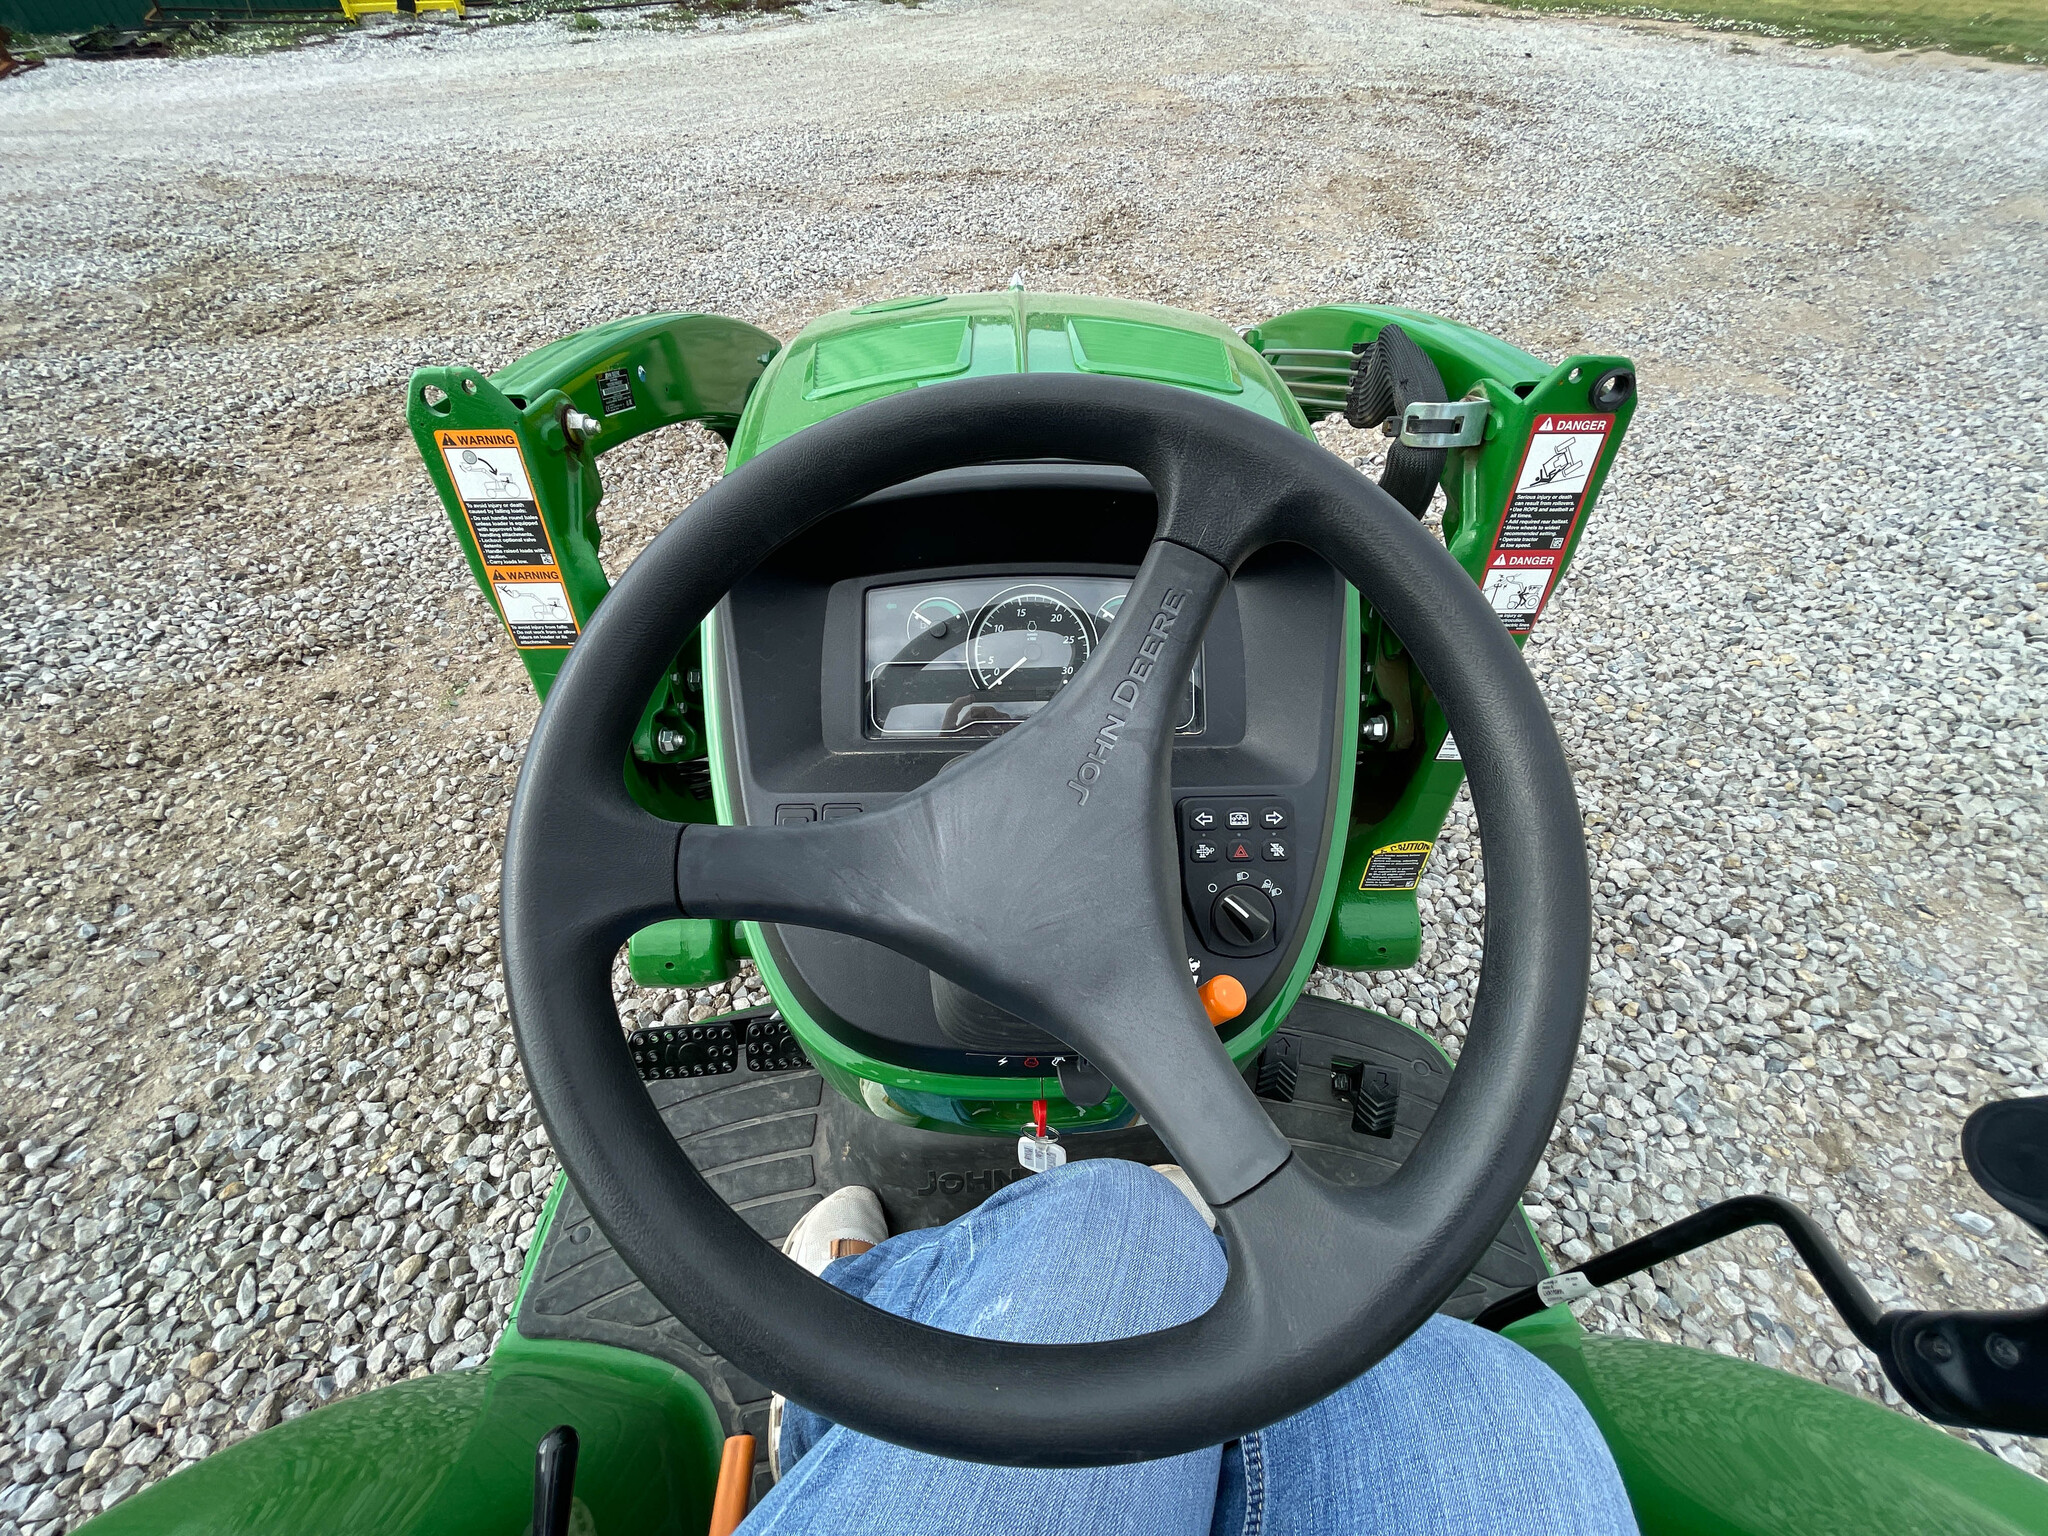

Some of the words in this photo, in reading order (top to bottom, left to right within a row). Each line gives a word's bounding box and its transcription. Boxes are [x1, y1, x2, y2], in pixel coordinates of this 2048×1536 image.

[1556, 420, 1606, 430] DANGER
[457, 435, 514, 445] WARNING
[1509, 557, 1554, 565] DANGER
[1067, 714, 1125, 806] JOHN
[1111, 588, 1186, 710] DEERE
[1391, 843, 1430, 851] CAUTION
